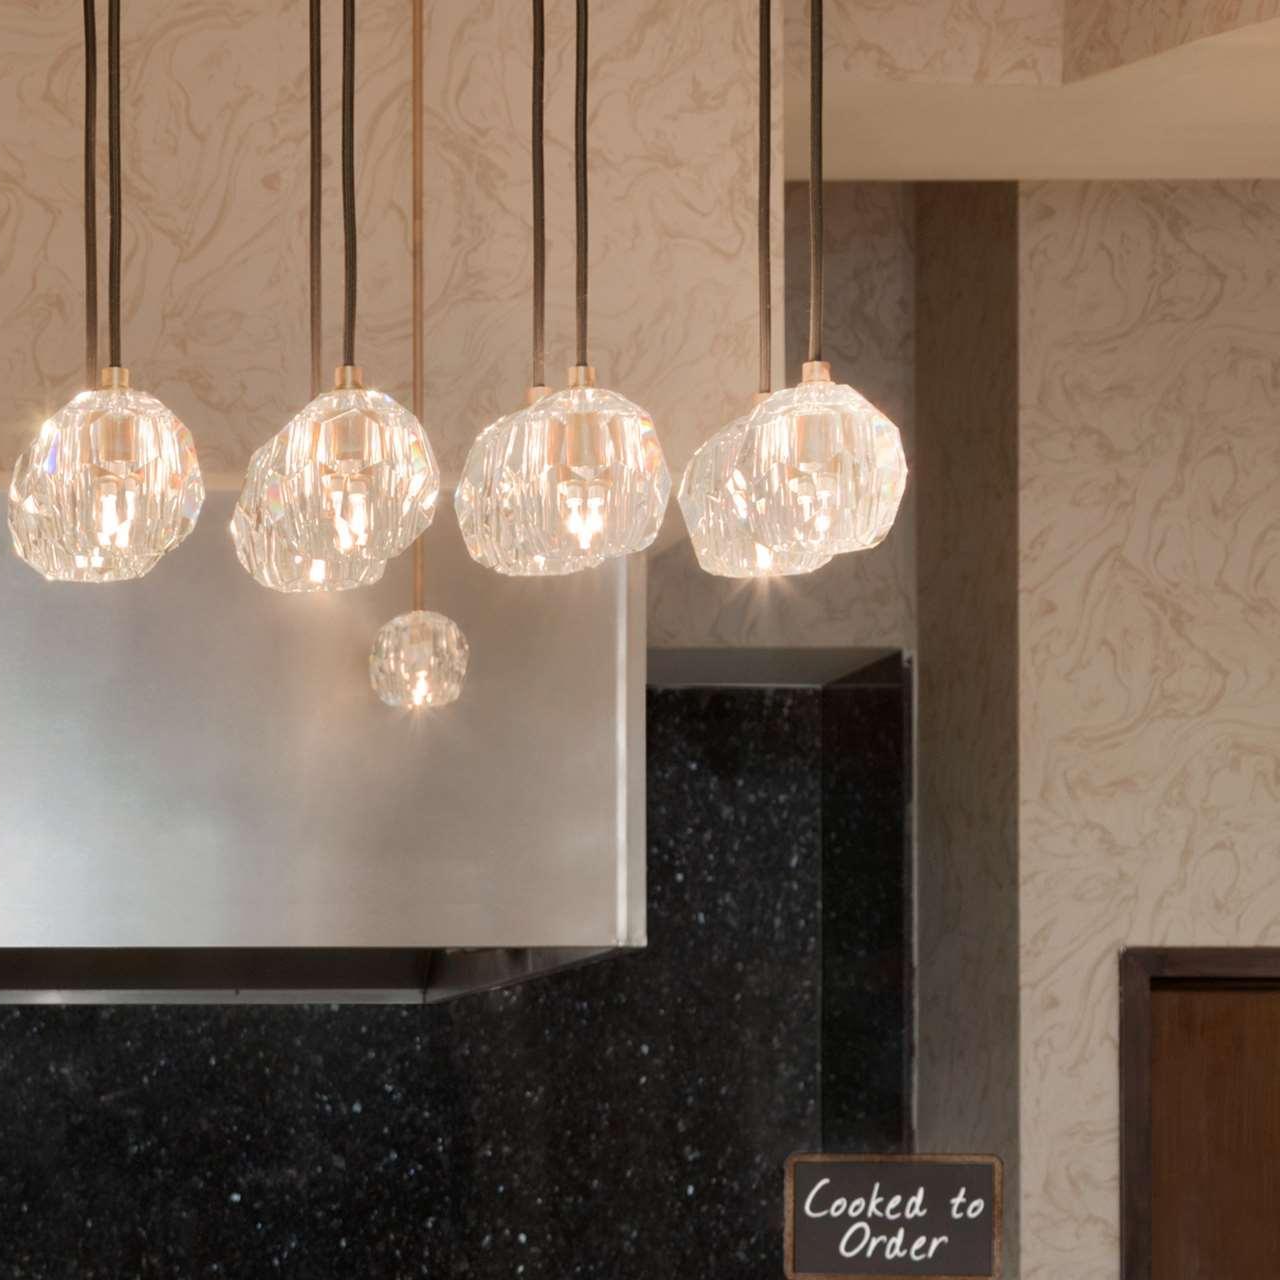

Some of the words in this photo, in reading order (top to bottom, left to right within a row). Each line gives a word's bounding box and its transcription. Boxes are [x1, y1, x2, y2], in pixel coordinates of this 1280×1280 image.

[803, 1177, 928, 1220] Cooked
[950, 1186, 985, 1219] to
[838, 1221, 949, 1261] Order
